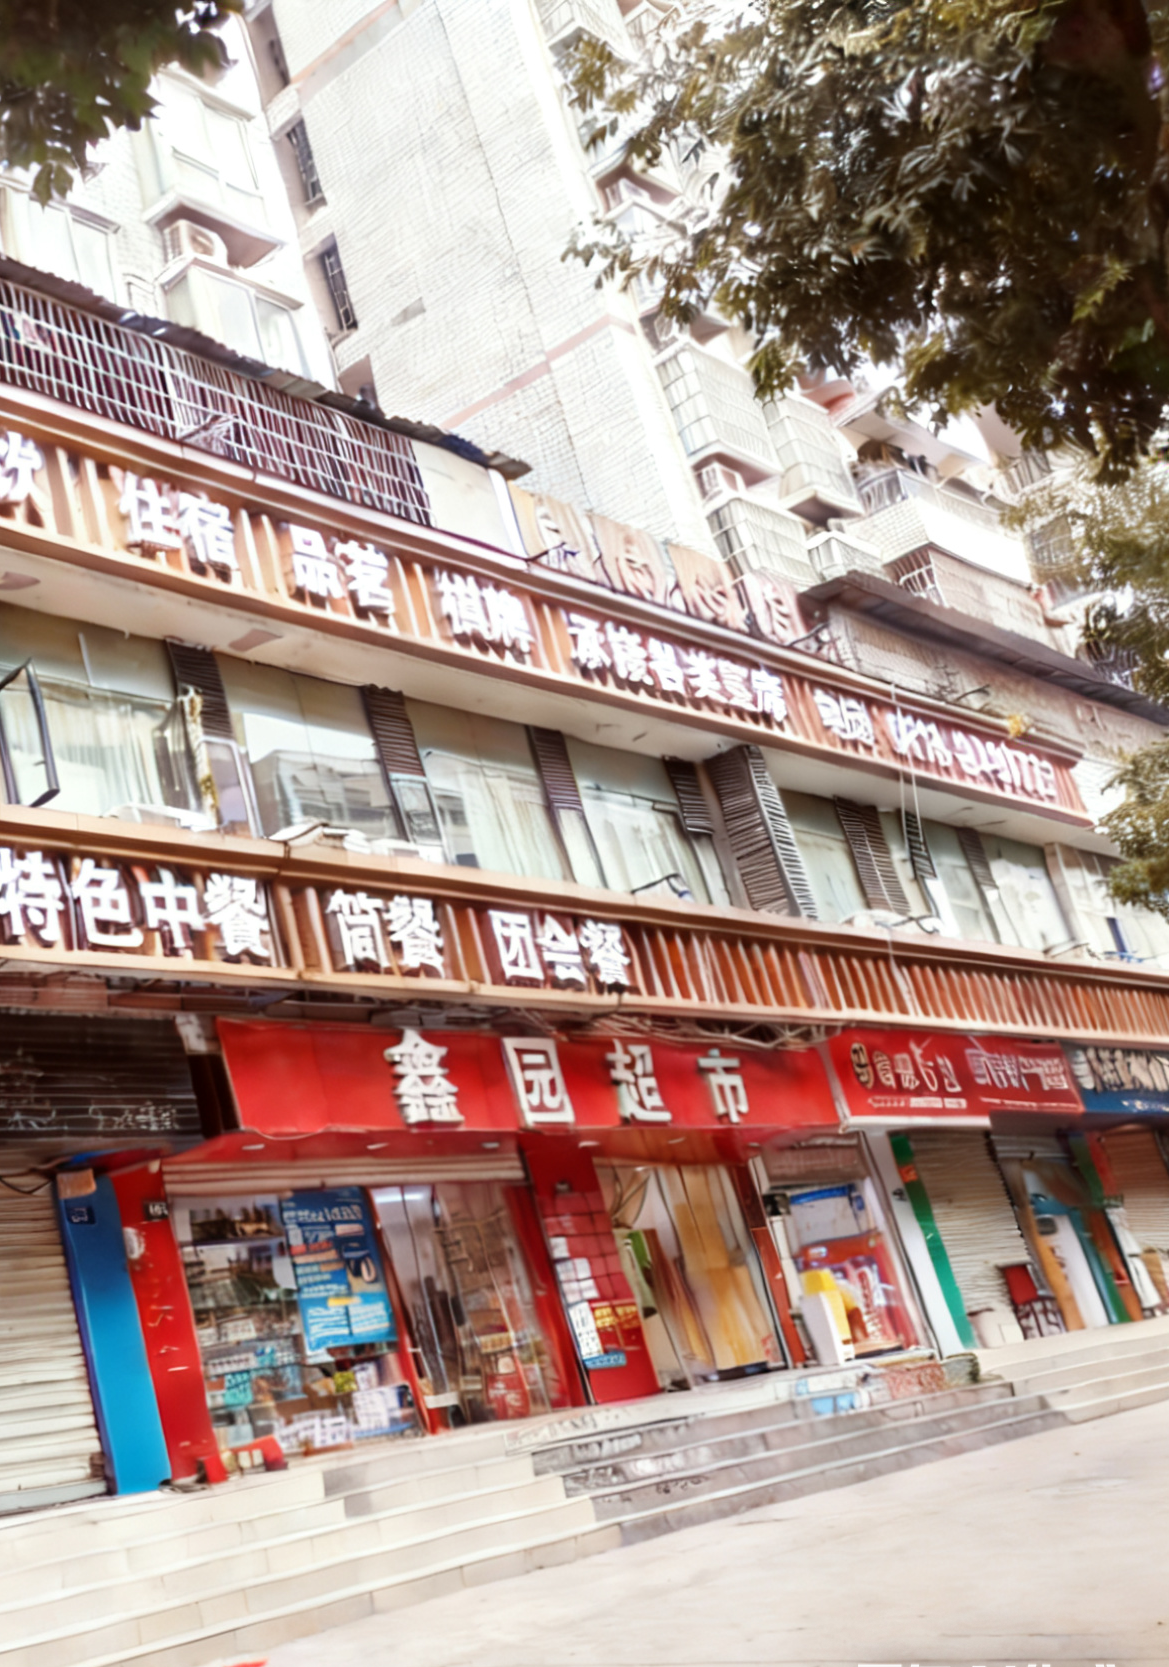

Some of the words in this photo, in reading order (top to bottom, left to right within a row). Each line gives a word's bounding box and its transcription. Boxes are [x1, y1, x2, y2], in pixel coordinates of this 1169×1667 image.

[119, 470, 235, 574] 住宿
[434, 566, 536, 654] 棋牌
[327, 888, 445, 976] 简餐
[487, 909, 630, 987] 团会餐
[383, 1026, 749, 1126] 鑫园超市
